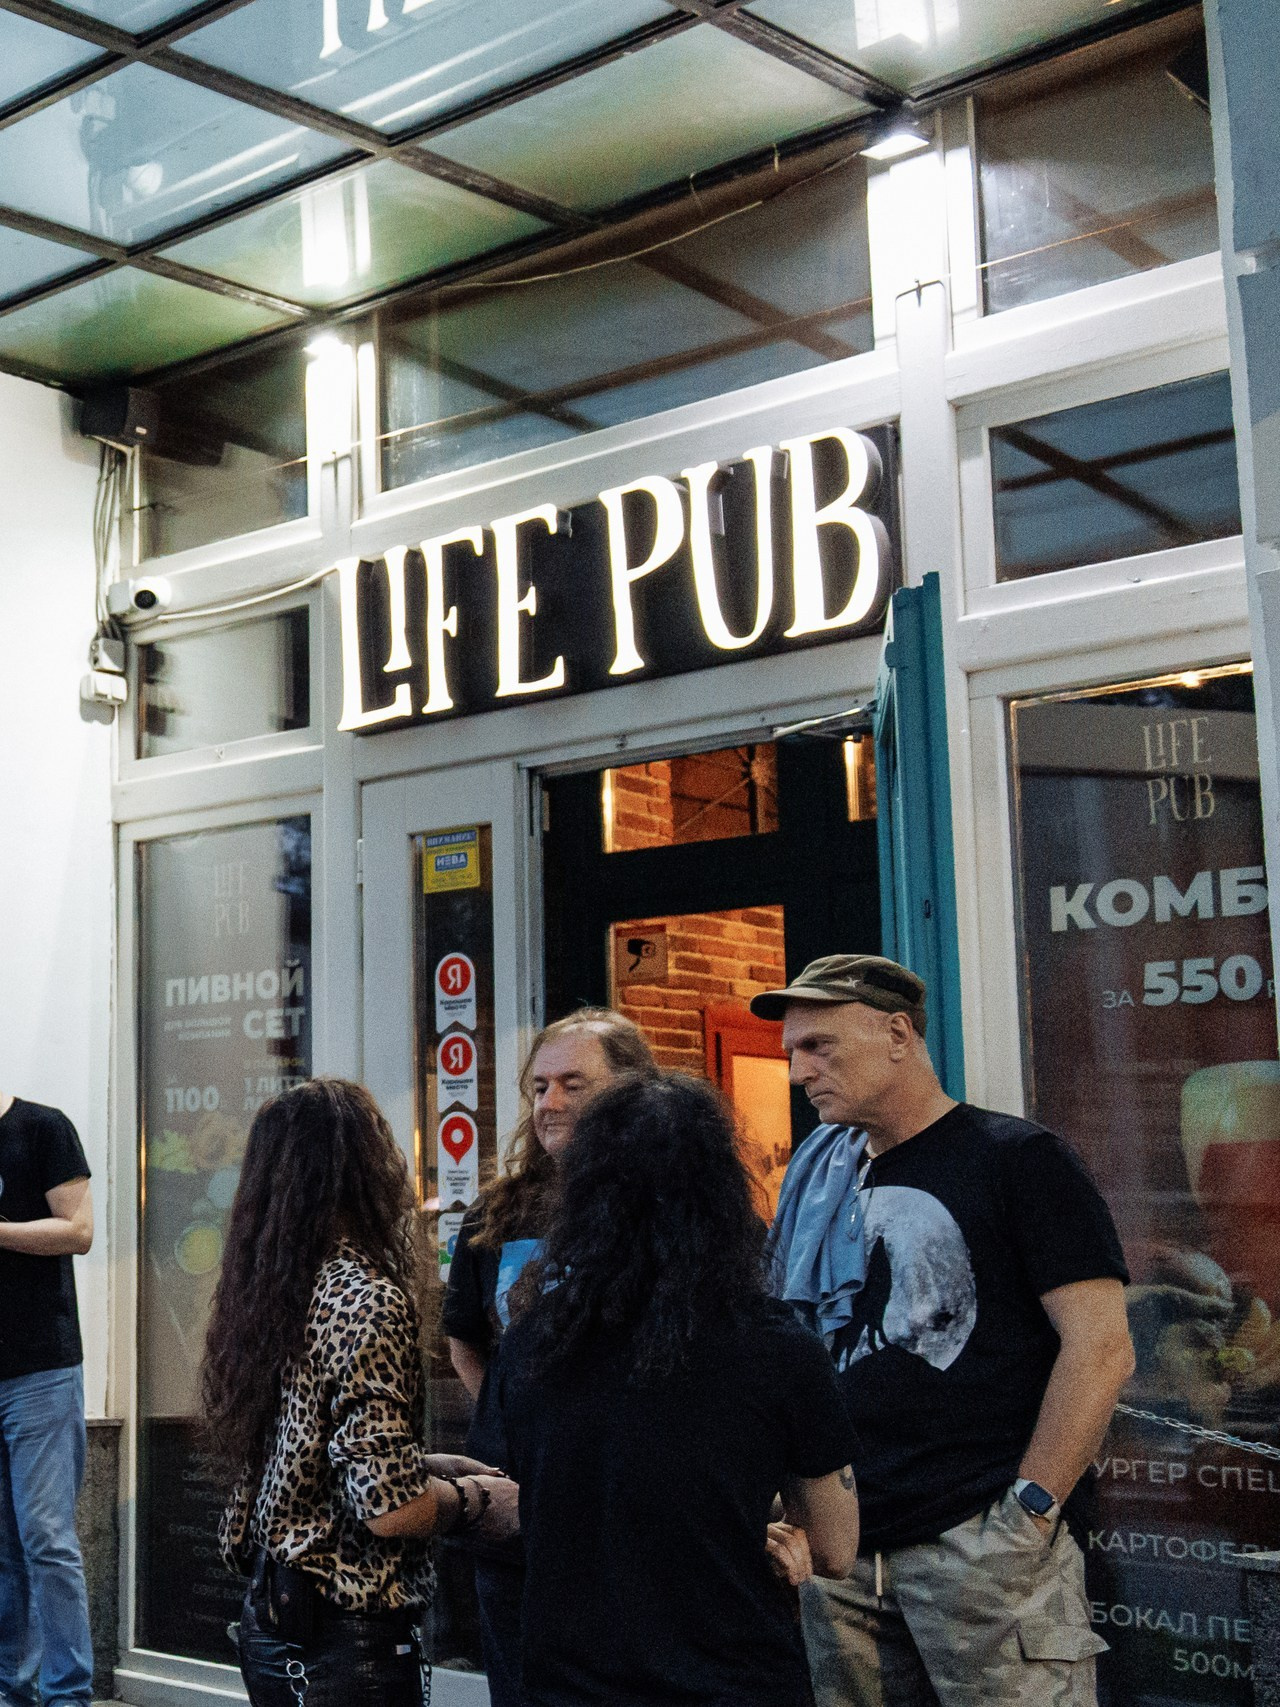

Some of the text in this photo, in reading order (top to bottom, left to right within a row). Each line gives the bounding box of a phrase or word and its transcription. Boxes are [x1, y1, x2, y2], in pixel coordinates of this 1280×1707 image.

[336, 426, 885, 733] LIFE PUB
[1142, 716, 1213, 772] LIFE
[1148, 772, 1216, 826] PUB
[165, 959, 305, 1007] ПИВНОЙ
[1101, 990, 1136, 1009] ЗА
[1142, 953, 1263, 1007] 550
[242, 1007, 306, 1039] СЕТ
[165, 1085, 220, 1113] 1100
[1093, 1457, 1188, 1485] УРГЕР
[1087, 1529, 1271, 1565] КАРТОФЕ
[1090, 1601, 1198, 1637] БОКАЛ
